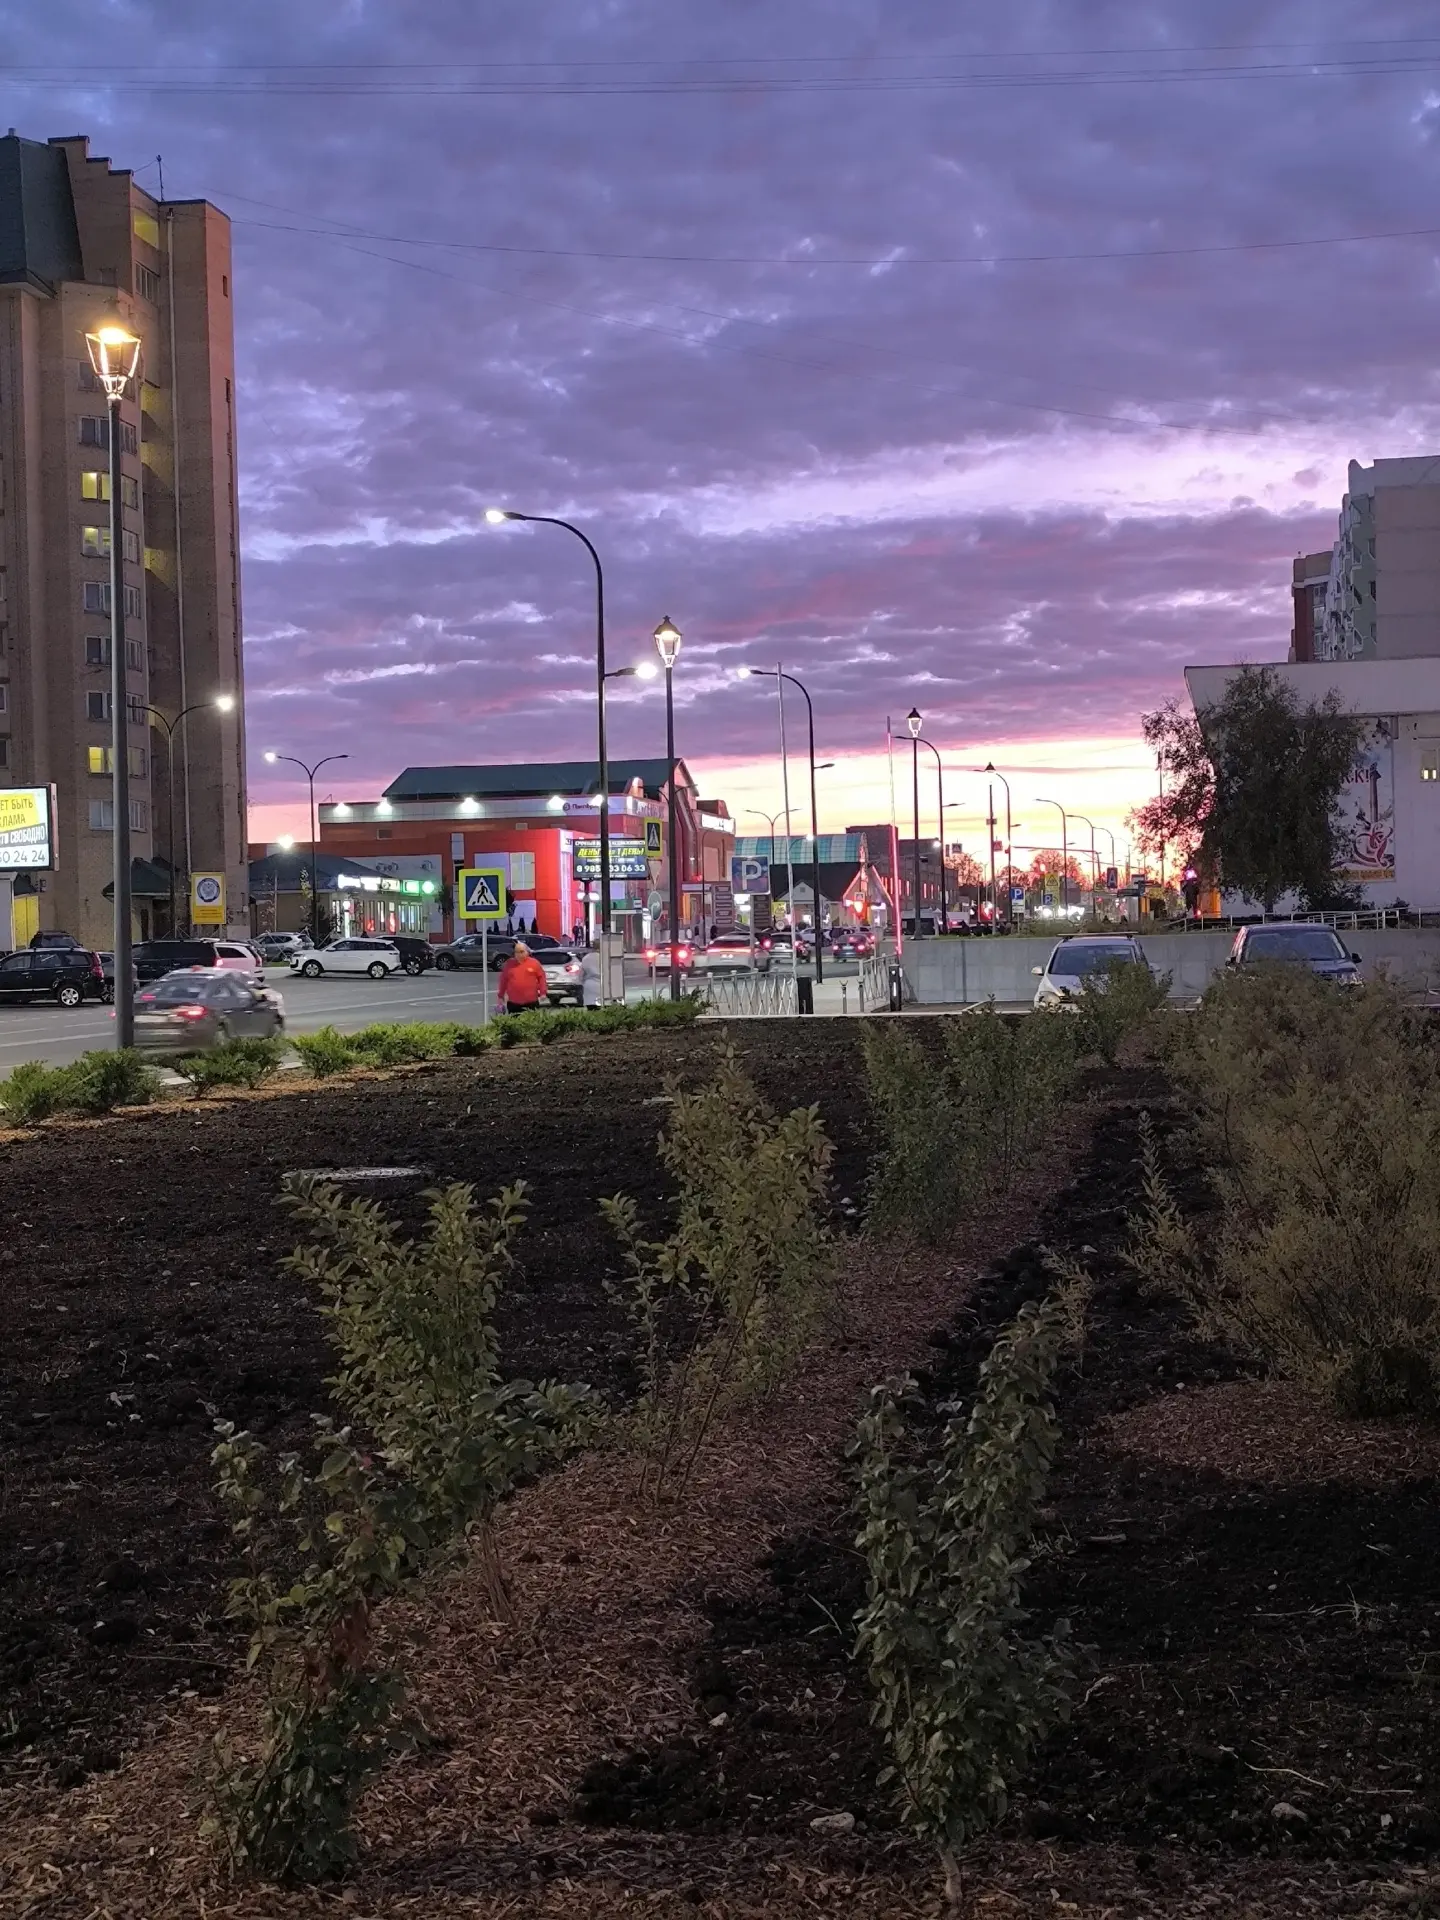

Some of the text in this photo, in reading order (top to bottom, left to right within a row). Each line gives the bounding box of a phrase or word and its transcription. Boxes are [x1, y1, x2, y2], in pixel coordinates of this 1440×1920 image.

[11, 799, 33, 810] БЫТЬ
[10, 825, 45, 844] СВОБОДНО
[13, 850, 27, 863] 24
[32, 850, 46, 862] 24
